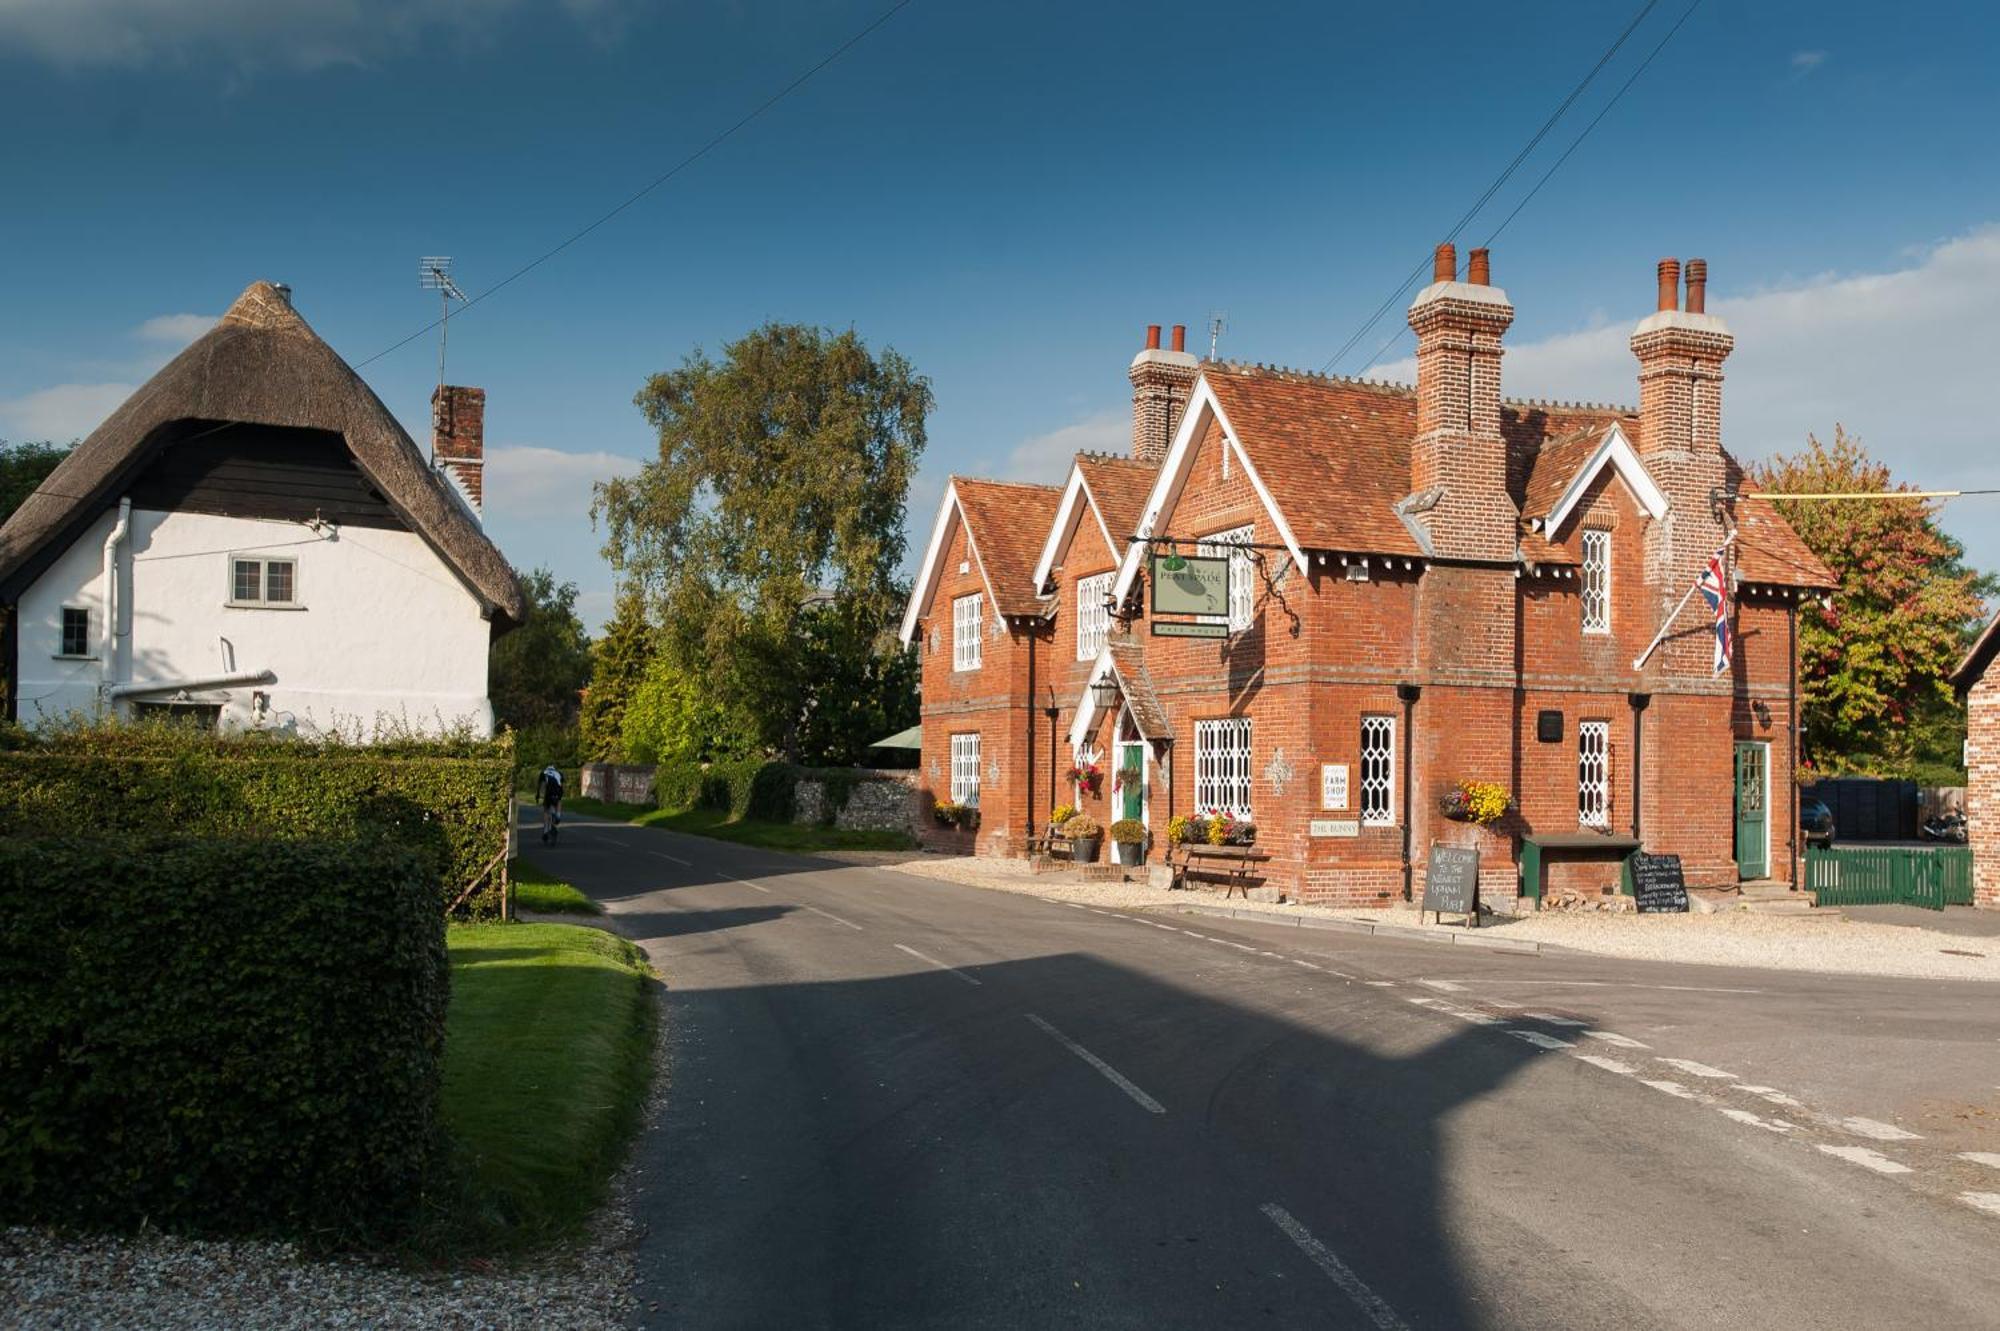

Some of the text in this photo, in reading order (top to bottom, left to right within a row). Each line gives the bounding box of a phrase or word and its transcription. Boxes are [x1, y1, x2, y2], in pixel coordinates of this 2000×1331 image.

[1161, 571, 1221, 582] PEAT SPADE
[1325, 775, 1346, 785] FARM
[1325, 786, 1346, 795] SHOP
[1313, 823, 1356, 832] THE BUNNY
